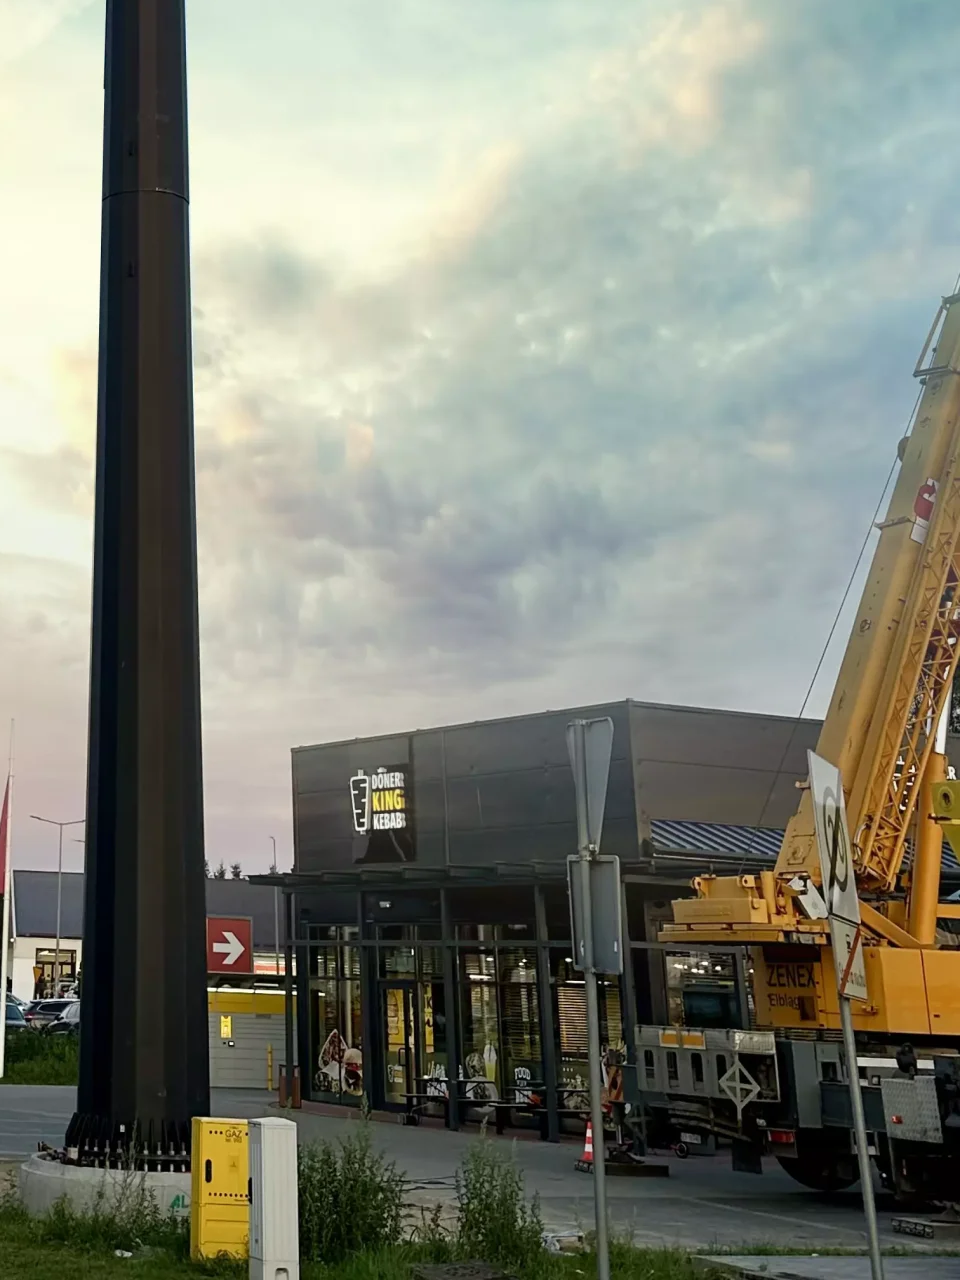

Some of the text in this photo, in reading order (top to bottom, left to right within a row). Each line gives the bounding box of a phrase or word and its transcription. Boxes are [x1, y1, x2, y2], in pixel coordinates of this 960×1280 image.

[372, 789, 405, 811] KING
[373, 812, 405, 829] KEBAB
[766, 963, 817, 988] ZENEX
[225, 1129, 243, 1138] GAZ
